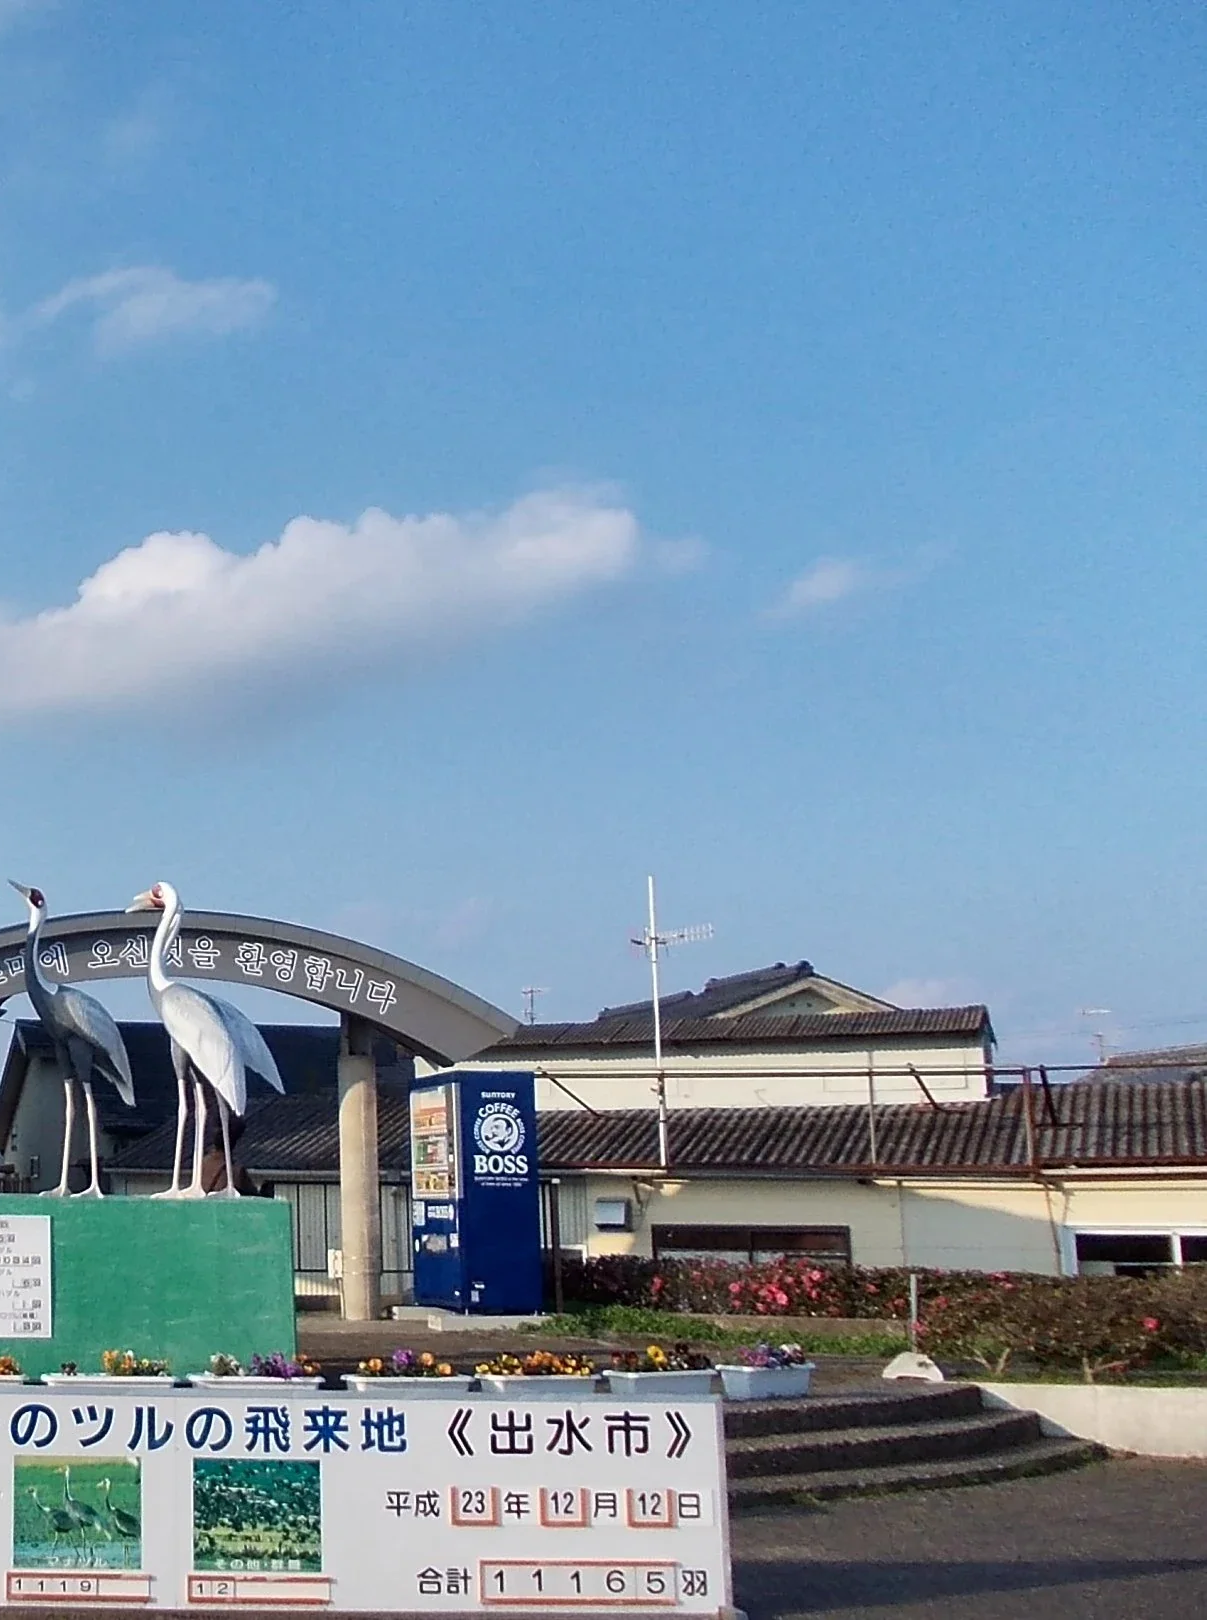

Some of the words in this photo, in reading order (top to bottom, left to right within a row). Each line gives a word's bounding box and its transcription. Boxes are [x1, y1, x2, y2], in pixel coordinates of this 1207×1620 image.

[235, 941, 398, 1016] 환영합니다
[478, 1102, 521, 1119] COFFEE
[473, 1154, 529, 1174] BOSS
[15, 1578, 92, 1592] 1119
[196, 1582, 229, 1595] 12
